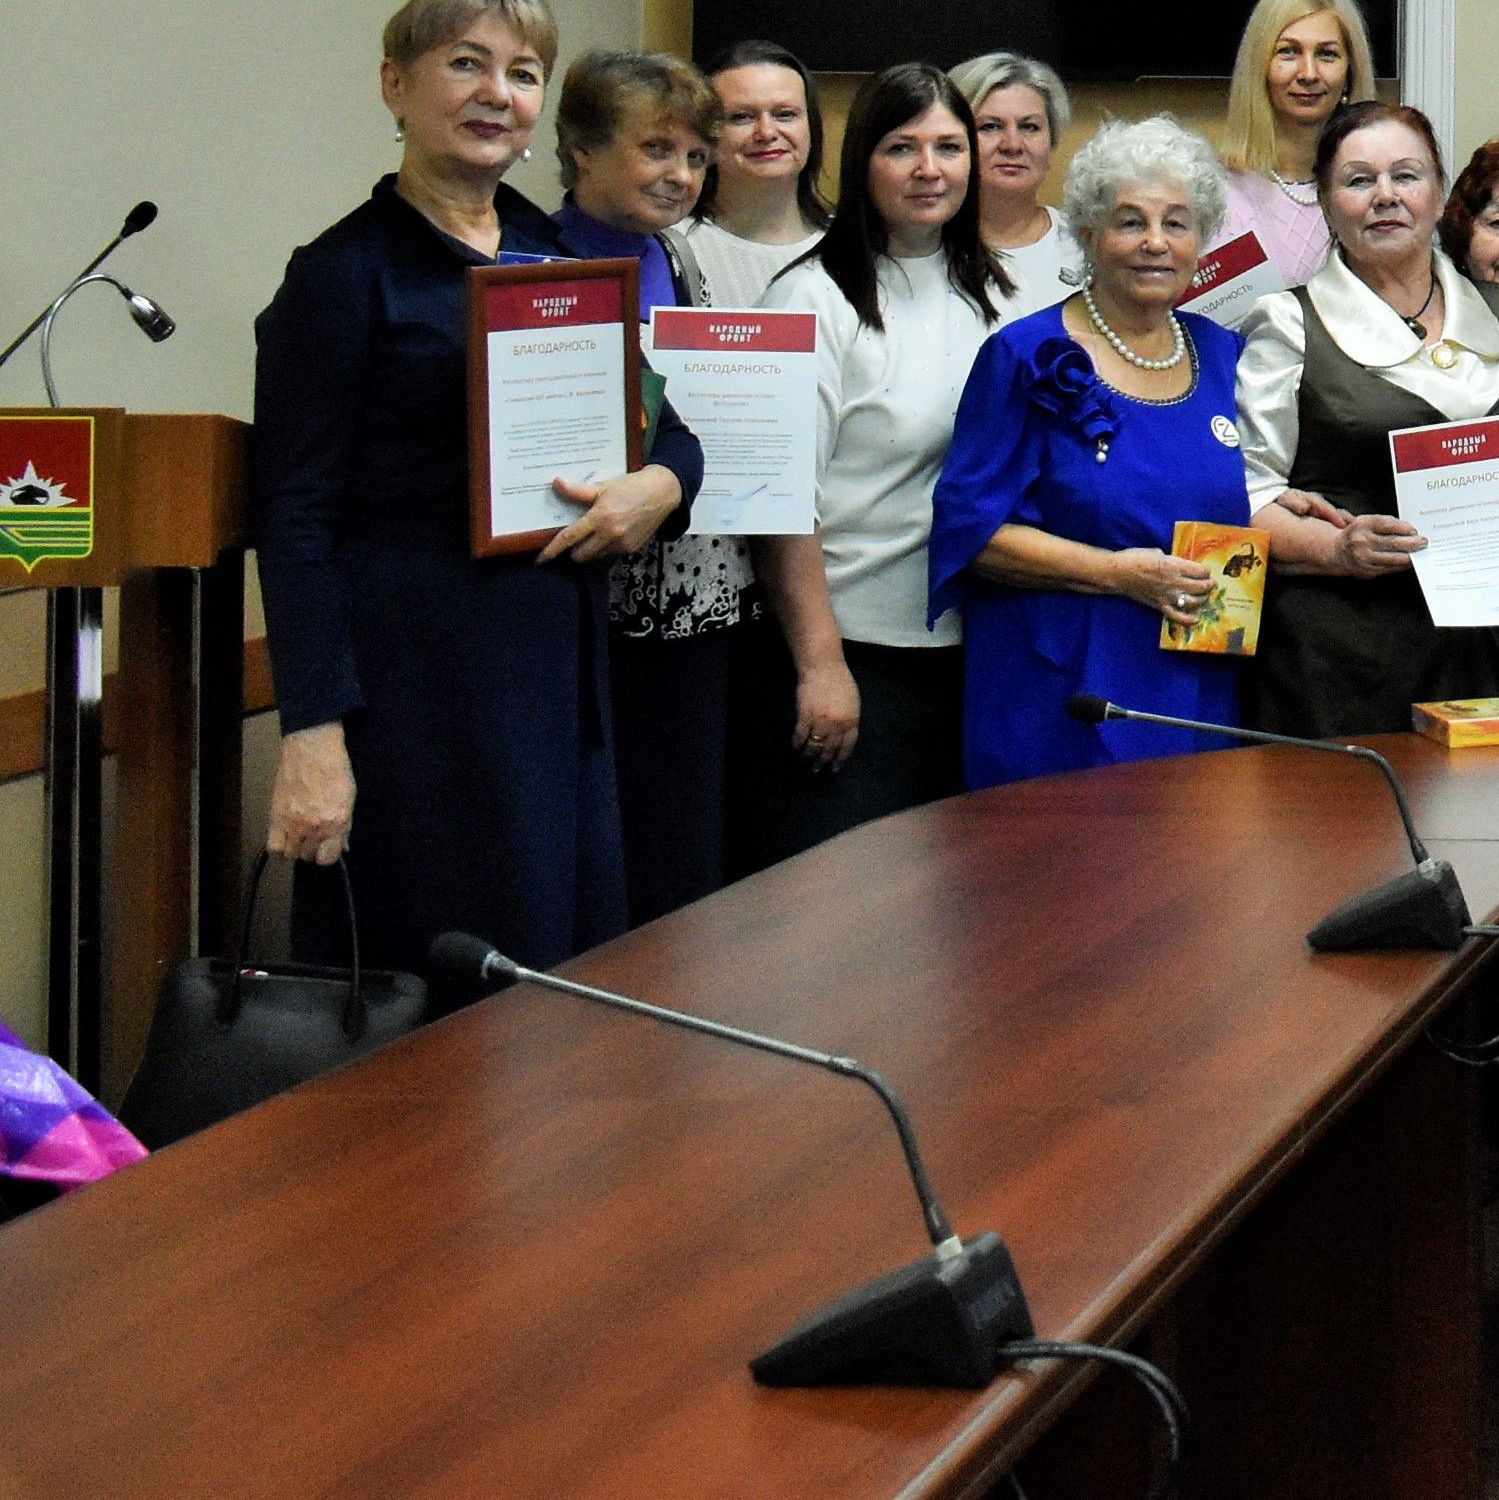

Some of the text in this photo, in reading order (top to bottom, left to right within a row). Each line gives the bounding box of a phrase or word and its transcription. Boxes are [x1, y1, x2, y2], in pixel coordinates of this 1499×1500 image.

[532, 296, 578, 308] НАРОДНЫЙ
[1196, 283, 1253, 314] ГОДАРНОСТЬ
[542, 306, 570, 317] ФРОНТ
[709, 324, 762, 334] НАРОДНЫЙ
[719, 334, 752, 342] ФРОНТ
[513, 340, 597, 356] БЛАГОДАРНОСТЬ
[684, 363, 782, 375] БЛАГОДАРНОСТЬ
[1442, 434, 1486, 449] НАРОДНЫЙ
[1451, 444, 1480, 456] ФРОНТ
